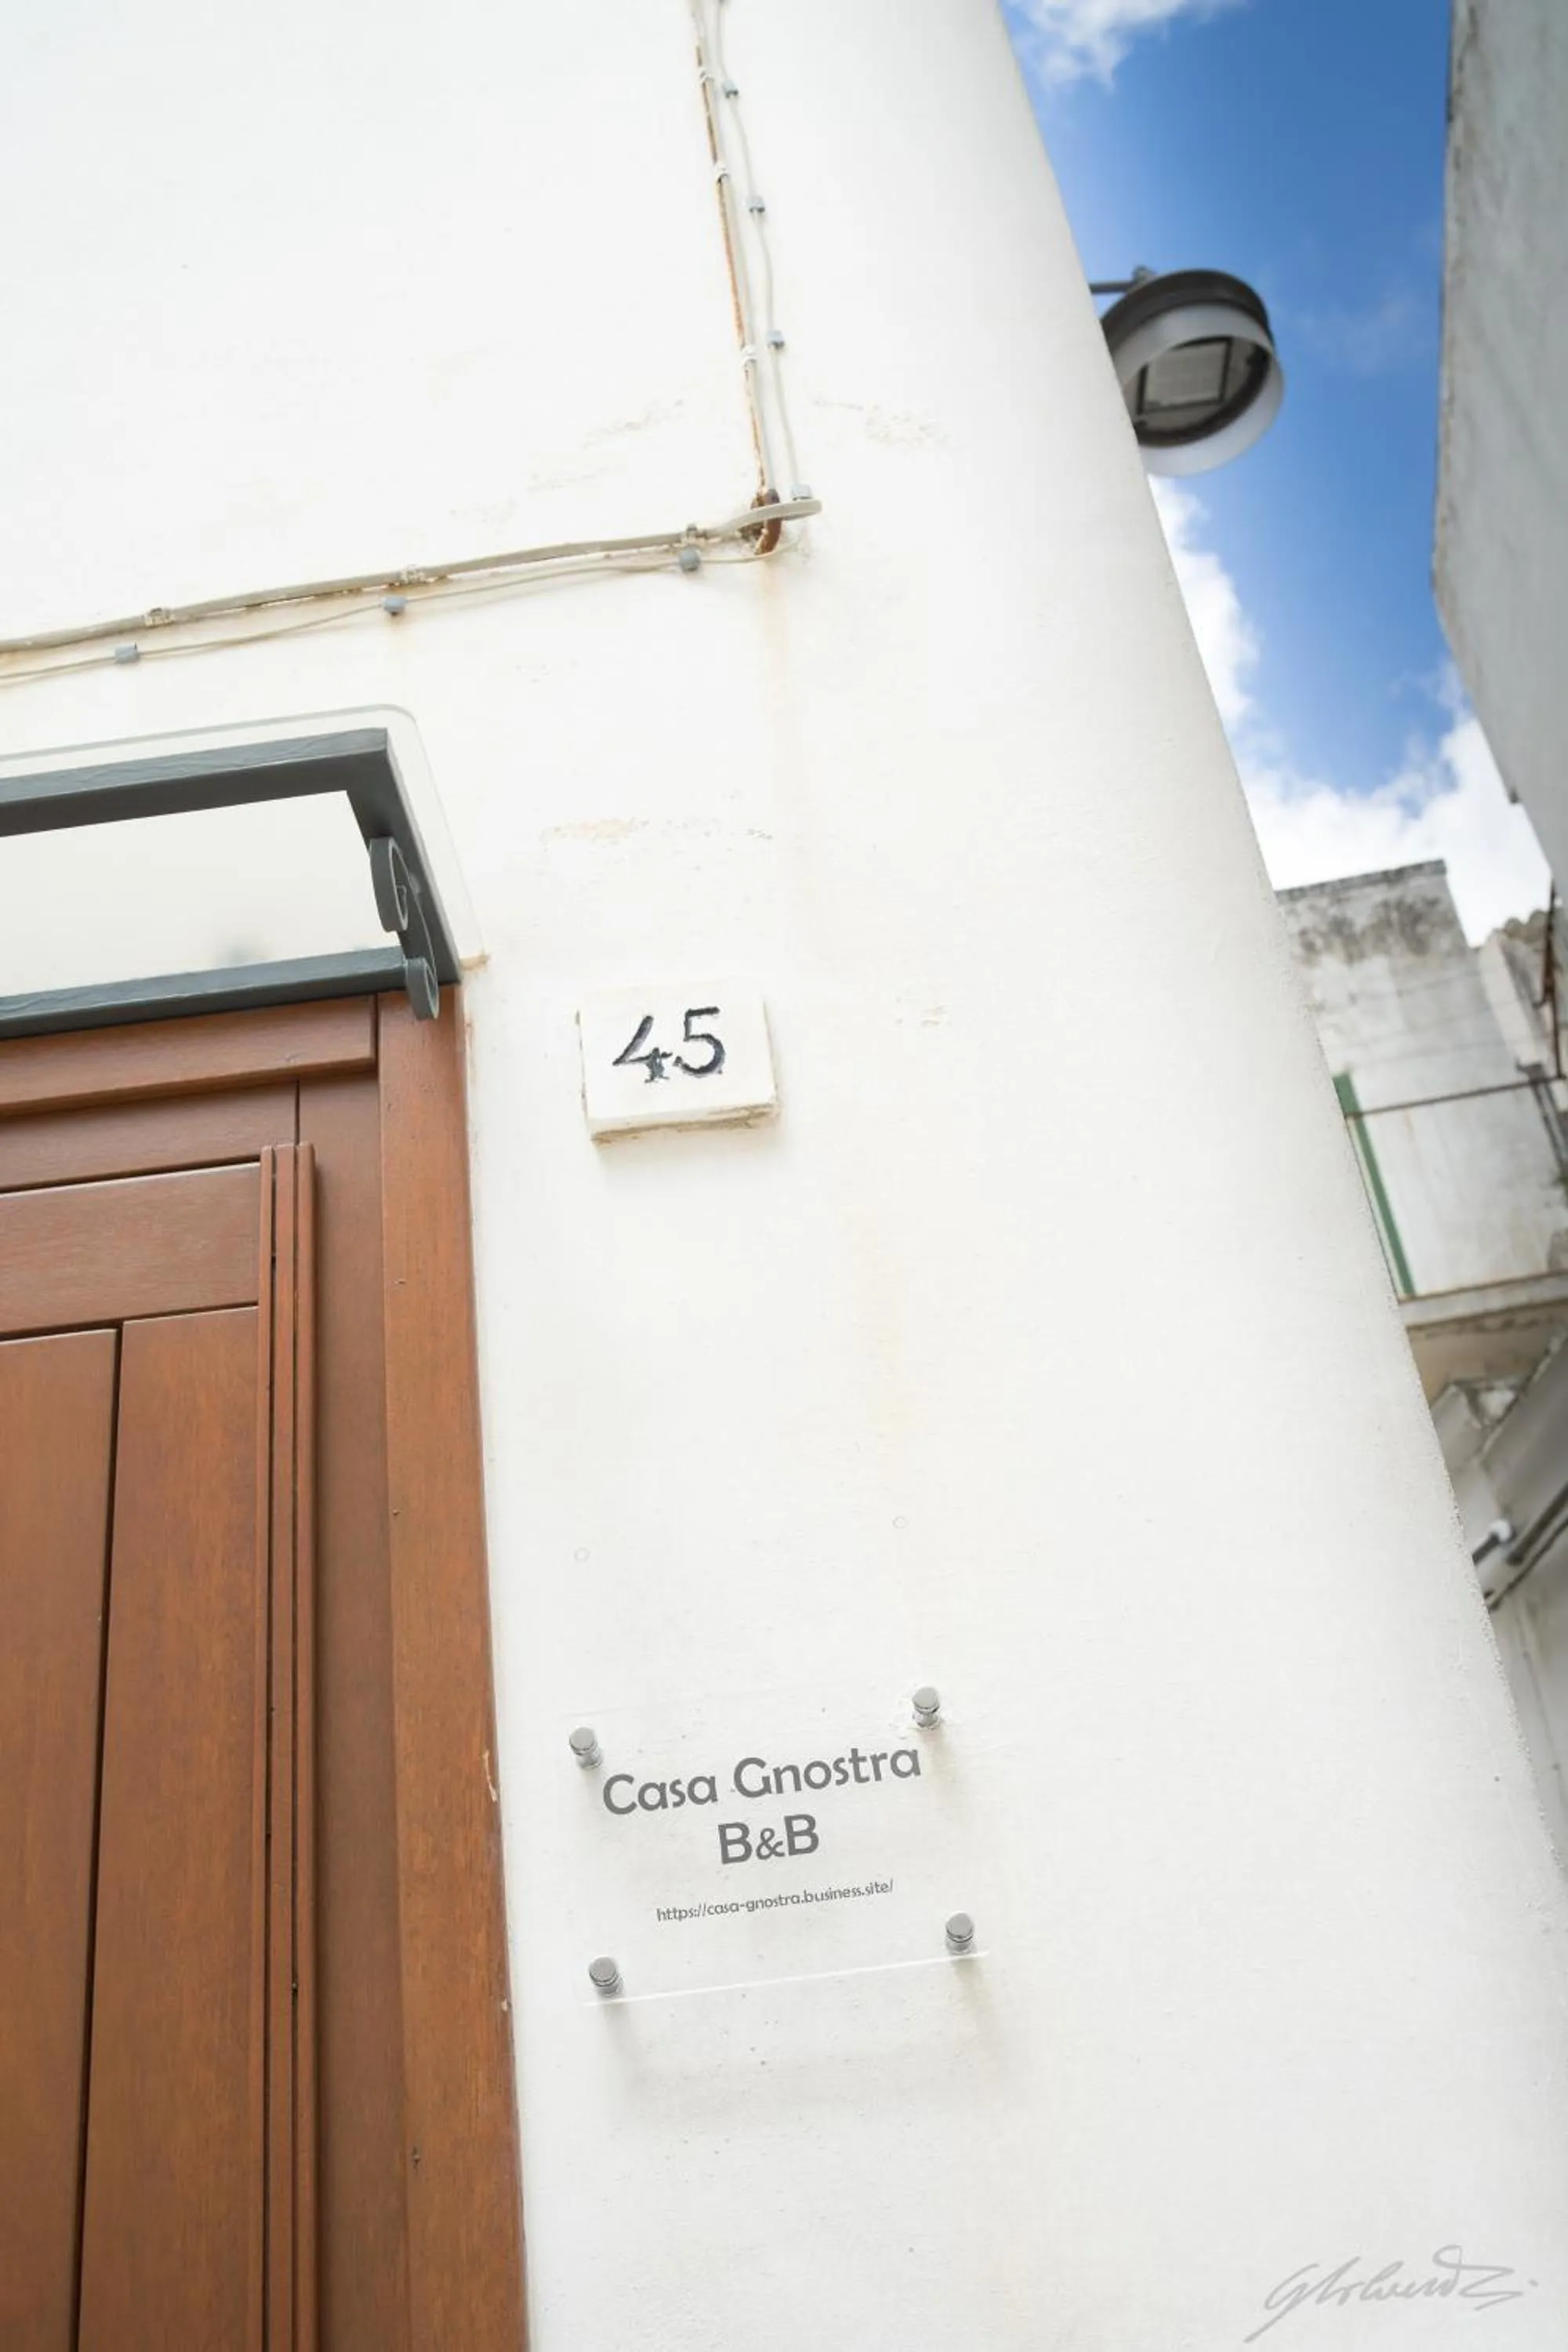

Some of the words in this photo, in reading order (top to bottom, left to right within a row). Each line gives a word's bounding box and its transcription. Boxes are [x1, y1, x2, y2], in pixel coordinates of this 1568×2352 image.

[612, 1006, 726, 1083] 45
[603, 1773, 718, 1815] Casa
[733, 1748, 922, 1798] Gnostra
[717, 1813, 820, 1865] B&B
[656, 1878, 895, 1922] https://casa-gnostra.business.site/
